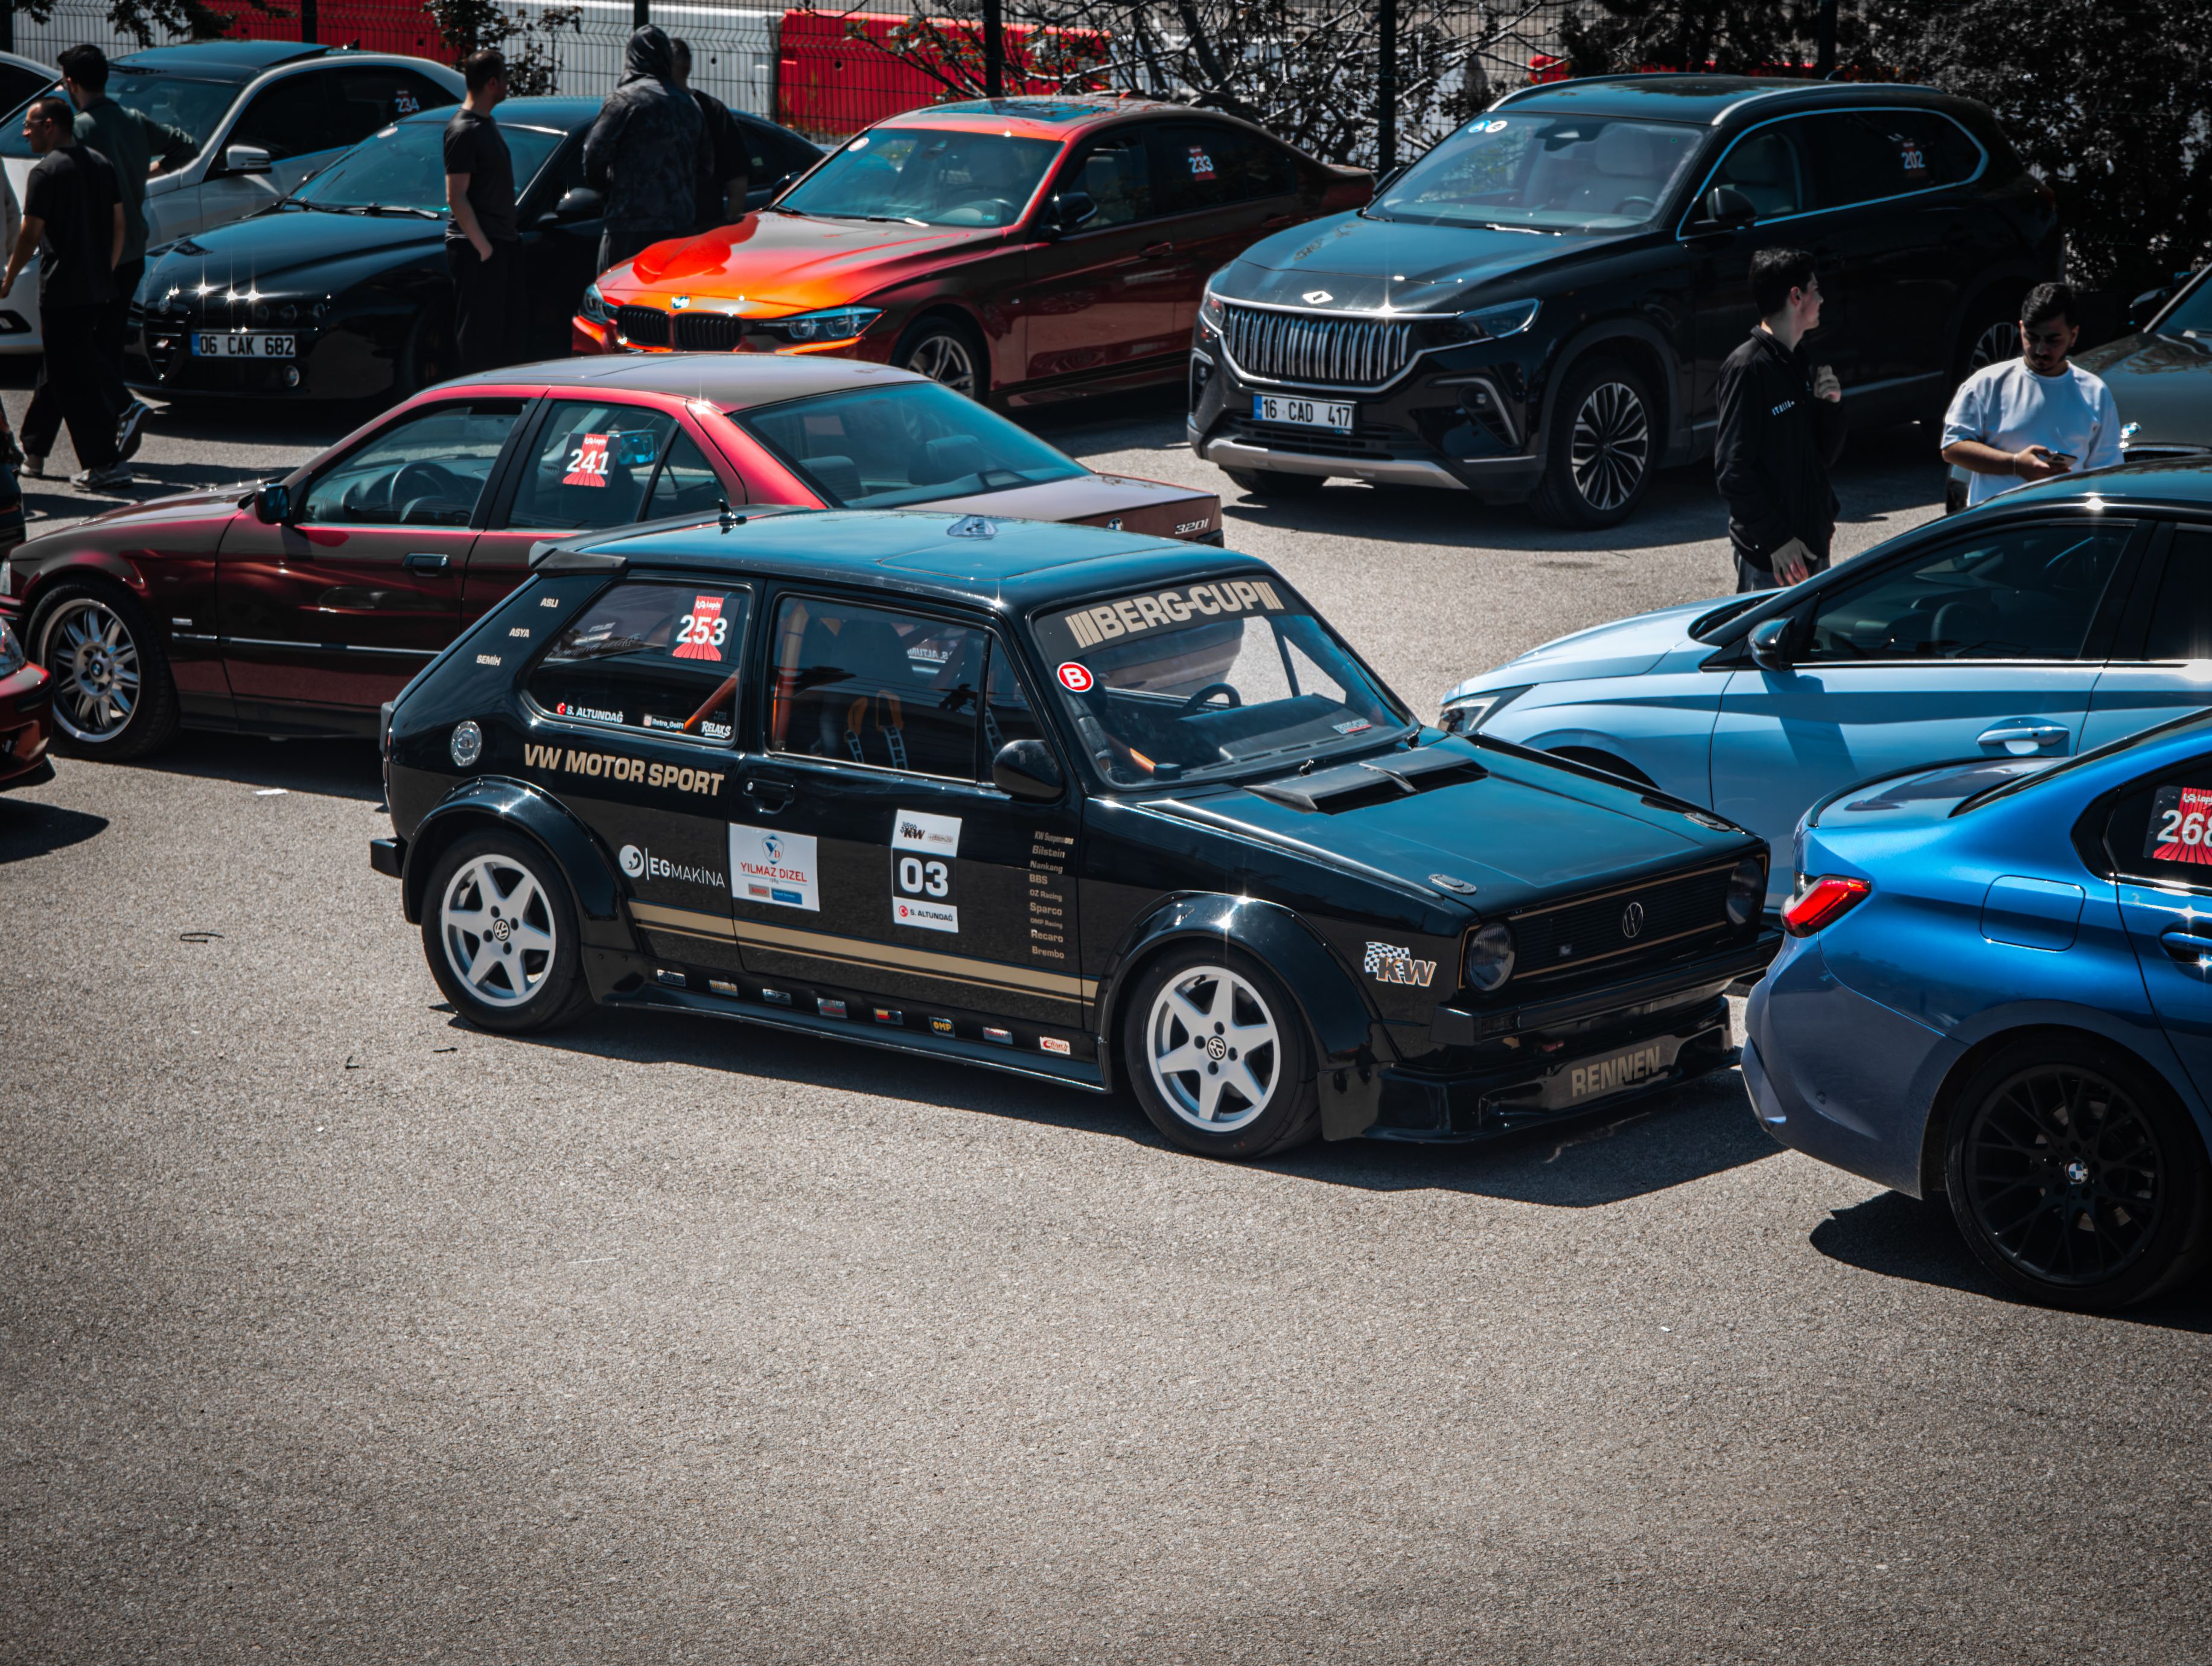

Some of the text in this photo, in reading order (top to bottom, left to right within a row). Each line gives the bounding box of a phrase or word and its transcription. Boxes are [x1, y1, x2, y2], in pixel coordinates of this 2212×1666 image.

[395, 97, 420, 112] 234
[1188, 155, 1214, 173] 233
[1901, 150, 1925, 169] 202
[200, 336, 295, 356] 06 CAK 682
[1264, 399, 1350, 426] 16 CAD 417
[566, 448, 610, 475] 241
[540, 597, 559, 608] ASLI
[509, 627, 530, 638] ASYA
[676, 614, 728, 646] 253
[476, 654, 502, 666] SEMİH
[1062, 667, 1087, 688] B
[566, 705, 624, 724] S. ALTUNDAĞ
[524, 743, 725, 796] VW MOTOR SPORT
[904, 828, 926, 840] KW
[1032, 844, 1066, 858] Bilstein
[741, 861, 777, 878] YILMAZ
[1030, 860, 1063, 874] Nankang
[899, 857, 949, 898] 03
[1029, 873, 1048, 885] BBS
[1041, 890, 1062, 902] Racing
[1030, 902, 1063, 916] Sparco
[1031, 928, 1063, 943] Recaro
[1032, 945, 1065, 959] Brembo
[1376, 956, 1436, 987] KW
[932, 1021, 952, 1032] OMP
[1571, 1044, 1660, 1097] RENNEN
